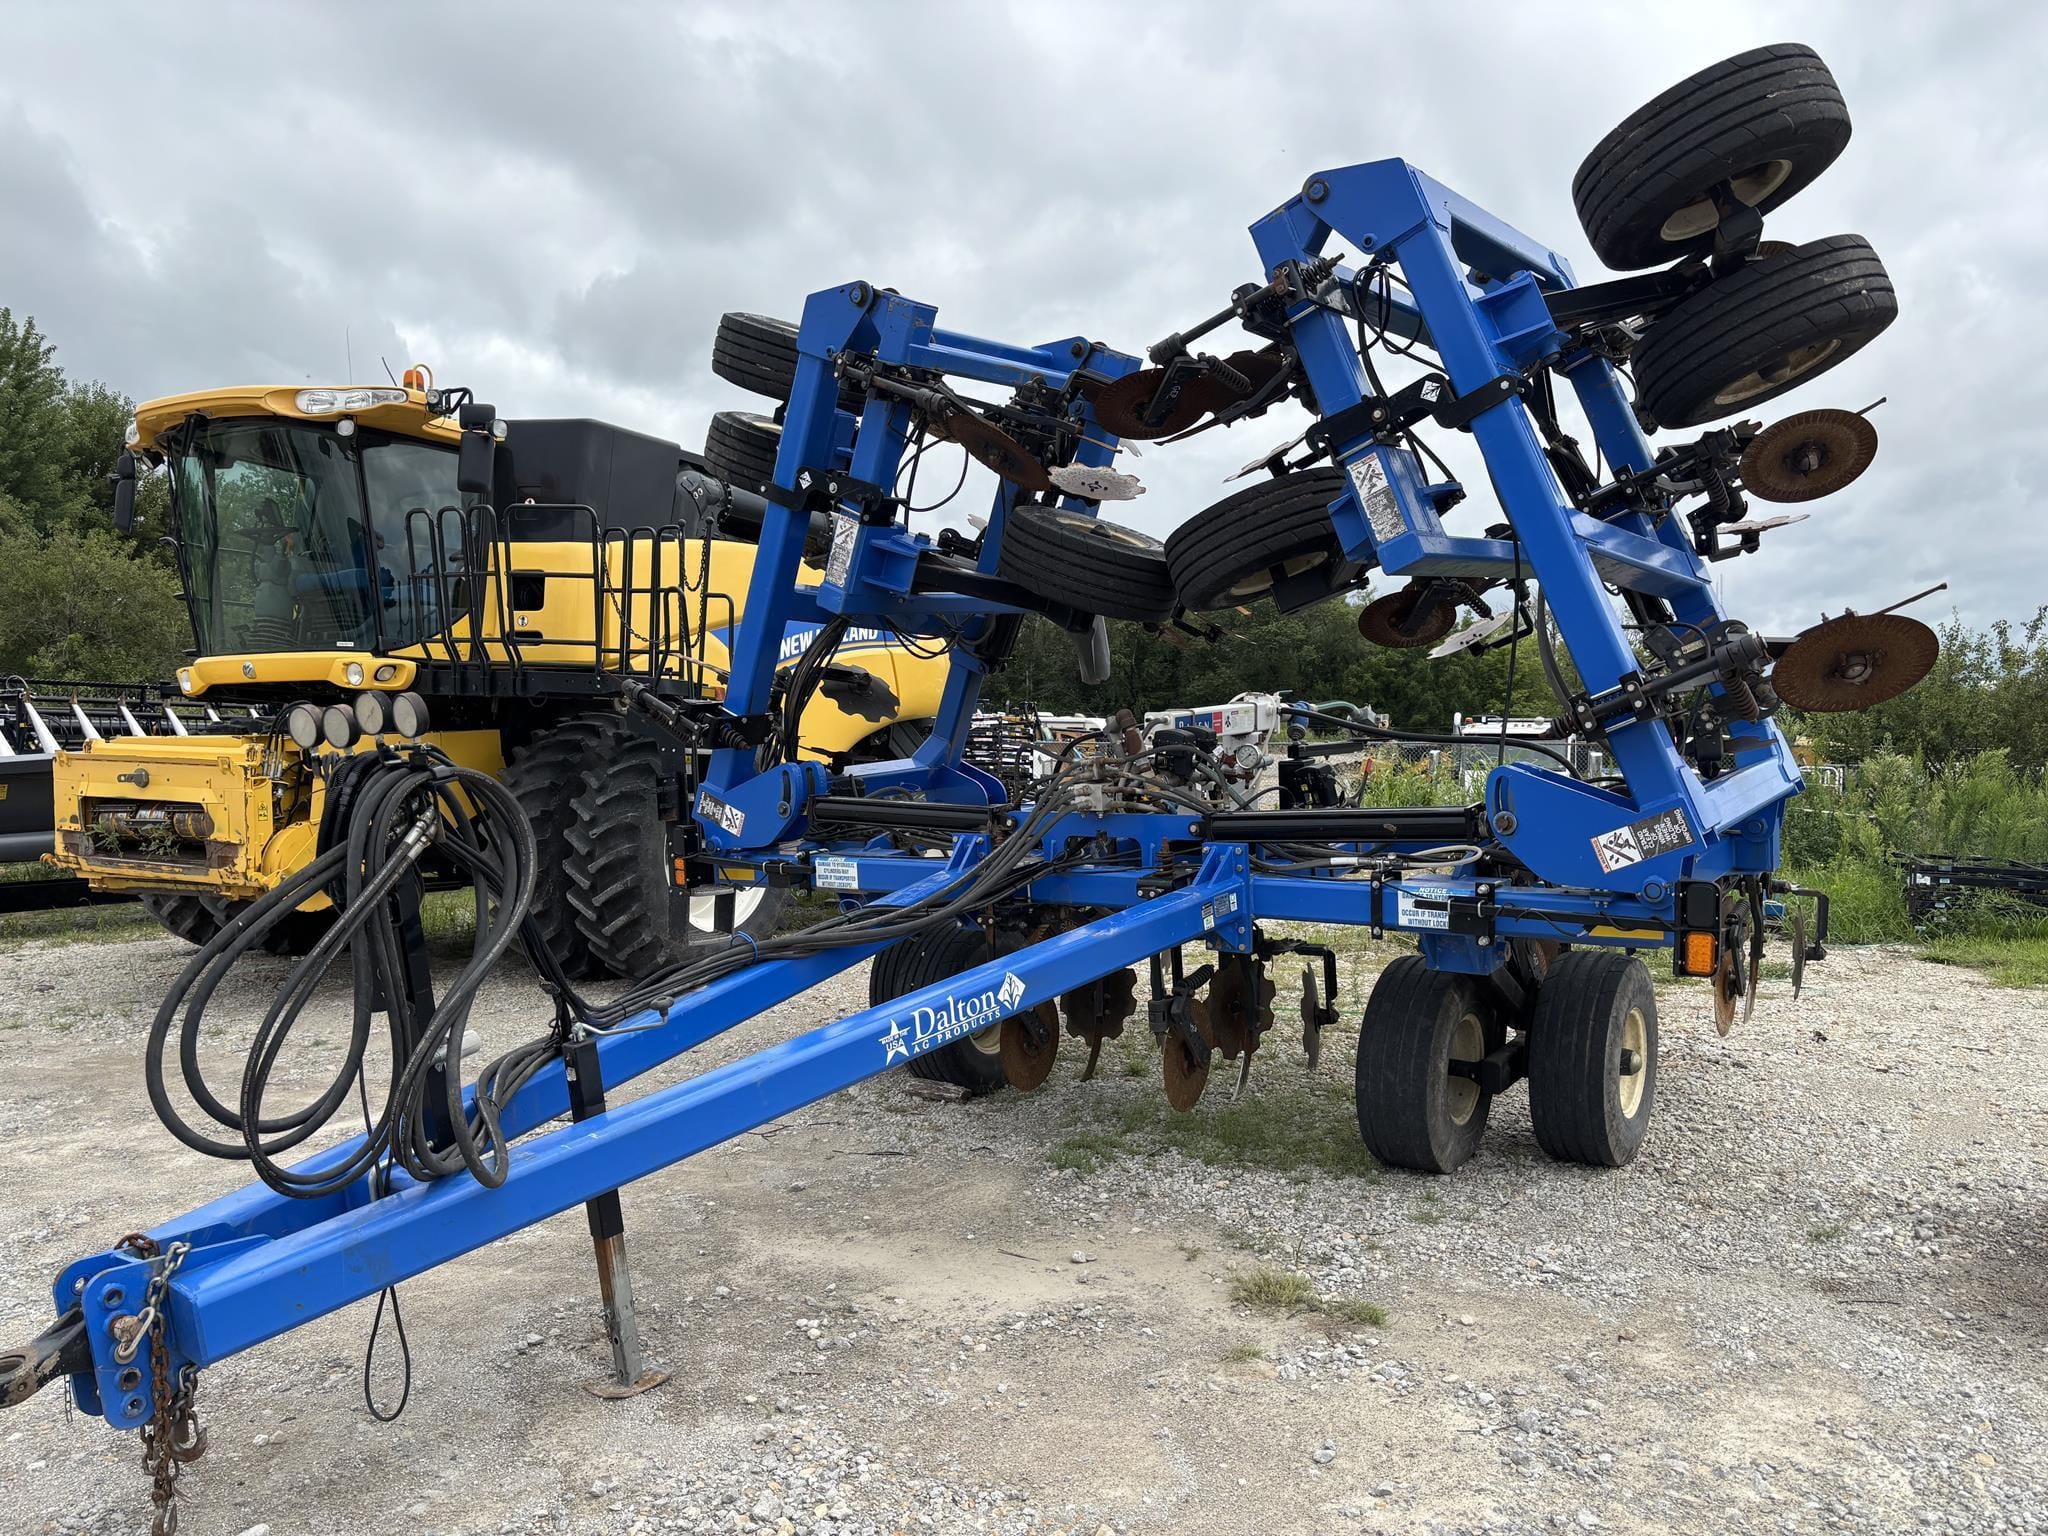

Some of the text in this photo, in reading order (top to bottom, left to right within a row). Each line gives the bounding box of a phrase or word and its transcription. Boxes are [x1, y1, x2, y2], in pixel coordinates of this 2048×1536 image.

[780, 629, 812, 660] NEW
[1653, 823, 1666, 844] WINGS
[1660, 822, 1671, 841] WHEN
[1664, 816, 1679, 843] FOLDING
[1673, 823, 1681, 834] OR
[1674, 808, 1692, 843] UNFOLDING
[1636, 830, 1649, 850] STAND
[1642, 827, 1655, 848] CLEAR
[1650, 831, 1658, 841] OF
[1402, 909, 1420, 917] OCCUR
[1427, 910, 1448, 919] TRANSP
[1407, 918, 1449, 928] WITHOUT LOCK
[910, 991, 998, 1041] Dalton
[913, 1010, 1000, 1054] AG PRODUCTS
[886, 1038, 905, 1051] USA
